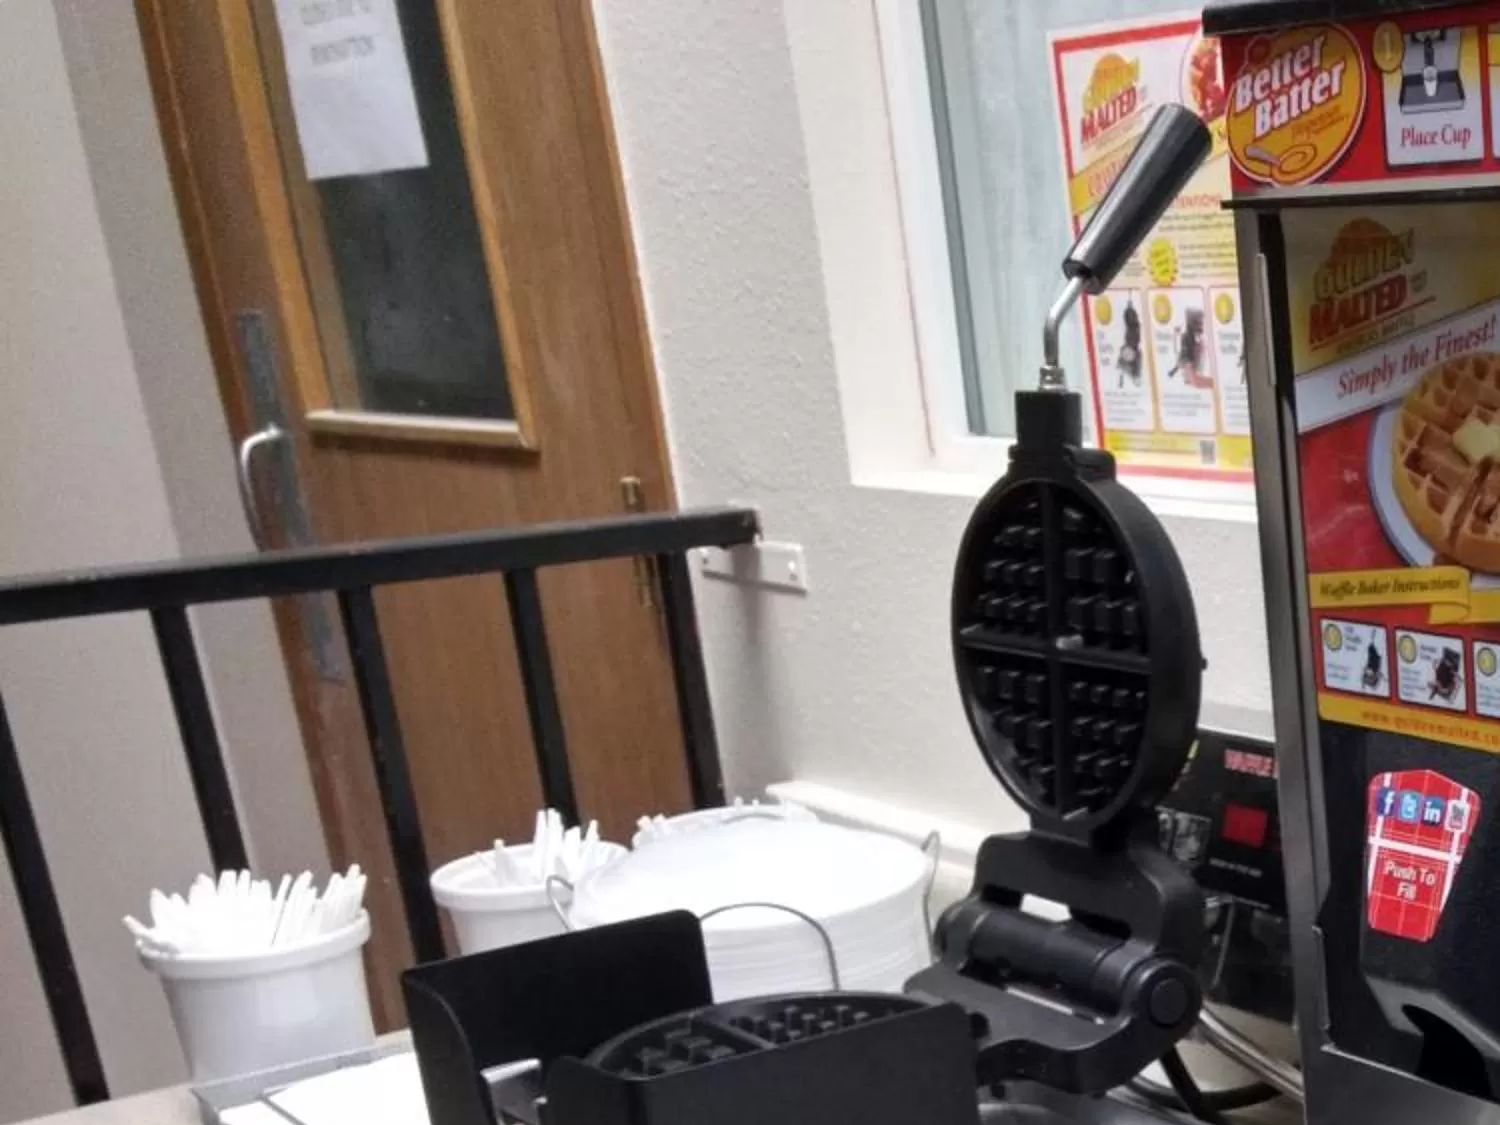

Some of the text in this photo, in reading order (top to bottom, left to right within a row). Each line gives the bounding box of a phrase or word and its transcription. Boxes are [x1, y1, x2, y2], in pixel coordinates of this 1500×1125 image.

[1235, 35, 1325, 113] Better
[1255, 61, 1345, 138] Batter
[1401, 123, 1472, 150] Place Cup
[1310, 273, 1407, 344] MALTED
[1338, 354, 1398, 399] Simply
[1402, 344, 1430, 374] the
[1435, 313, 1497, 361] Finest!
[1392, 573, 1460, 593] Instructions
[1384, 860, 1436, 886] Push To
[1397, 882, 1417, 900] Fill
